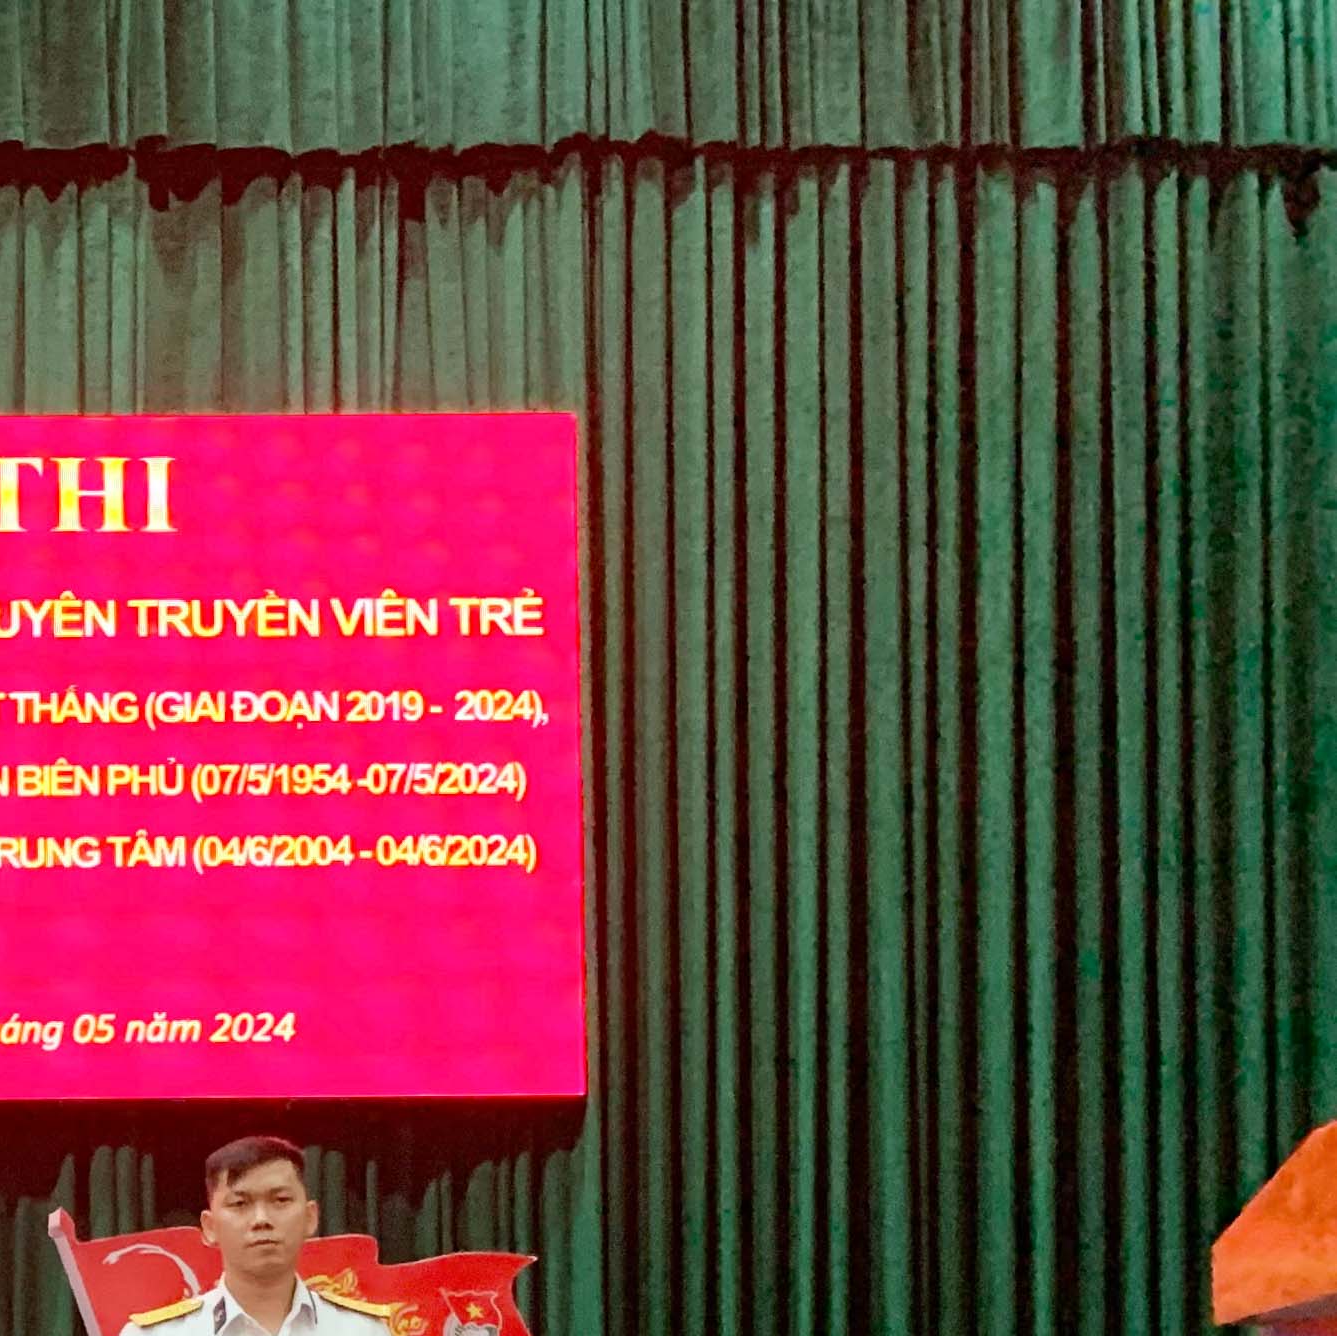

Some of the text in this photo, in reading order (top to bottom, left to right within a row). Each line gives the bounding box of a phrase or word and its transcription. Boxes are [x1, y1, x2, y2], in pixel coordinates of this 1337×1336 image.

[127, 588, 321, 638] TRUYỀN
[331, 589, 439, 638] VIÊN
[449, 587, 545, 637] TRẺ
[9, 684, 141, 726] THẮNG
[144, 690, 226, 731] (GIAI
[231, 691, 340, 731] ĐOẠN
[345, 690, 422, 722] 2019
[454, 689, 550, 729] 2024),
[15, 758, 103, 797] BIÊN
[108, 758, 185, 796] PHỦ
[190, 763, 352, 802] (07/5/1954
[106, 829, 186, 869] TÂM
[191, 836, 353, 873] (04/6/2004
[375, 834, 537, 872] 04/6/2024)
[72, 1014, 116, 1043] 05
[123, 1014, 202, 1043] năm
[208, 1013, 297, 1043] 2024
